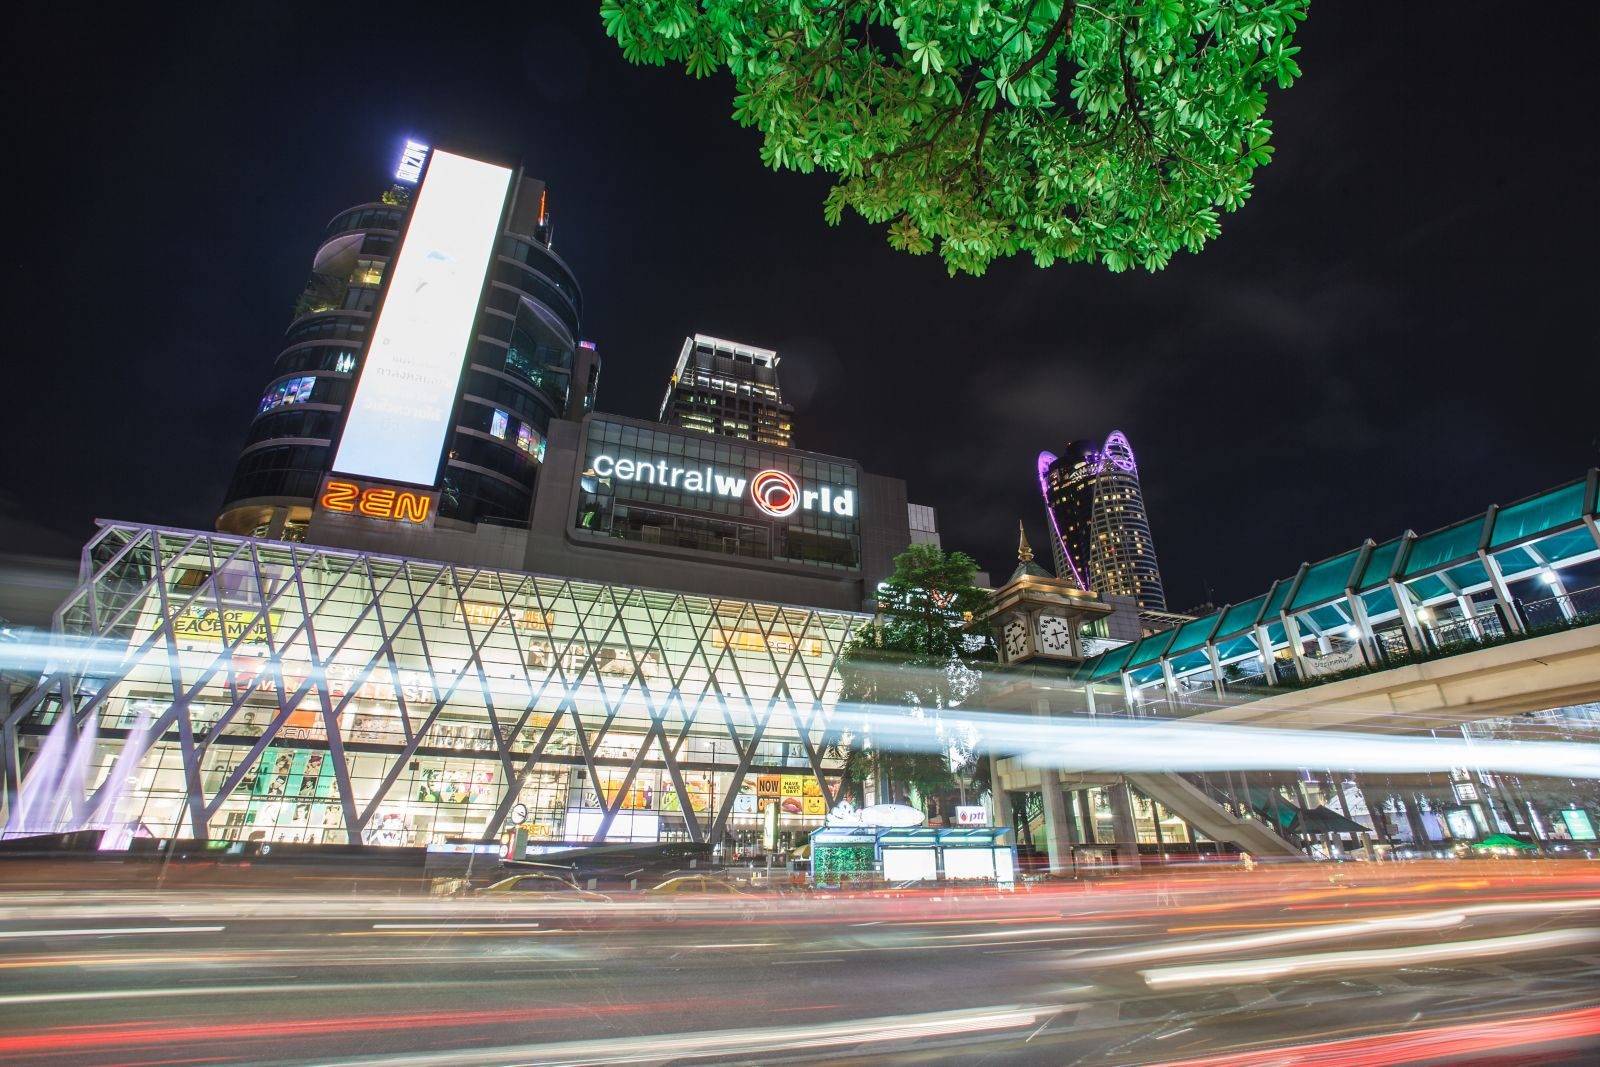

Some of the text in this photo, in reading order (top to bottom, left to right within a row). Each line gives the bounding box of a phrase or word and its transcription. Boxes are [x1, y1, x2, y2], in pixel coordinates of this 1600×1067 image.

[321, 481, 431, 524] ZEN
[224, 611, 243, 622] OF
[173, 618, 223, 634] EACE
[759, 780, 779, 792] NOW
